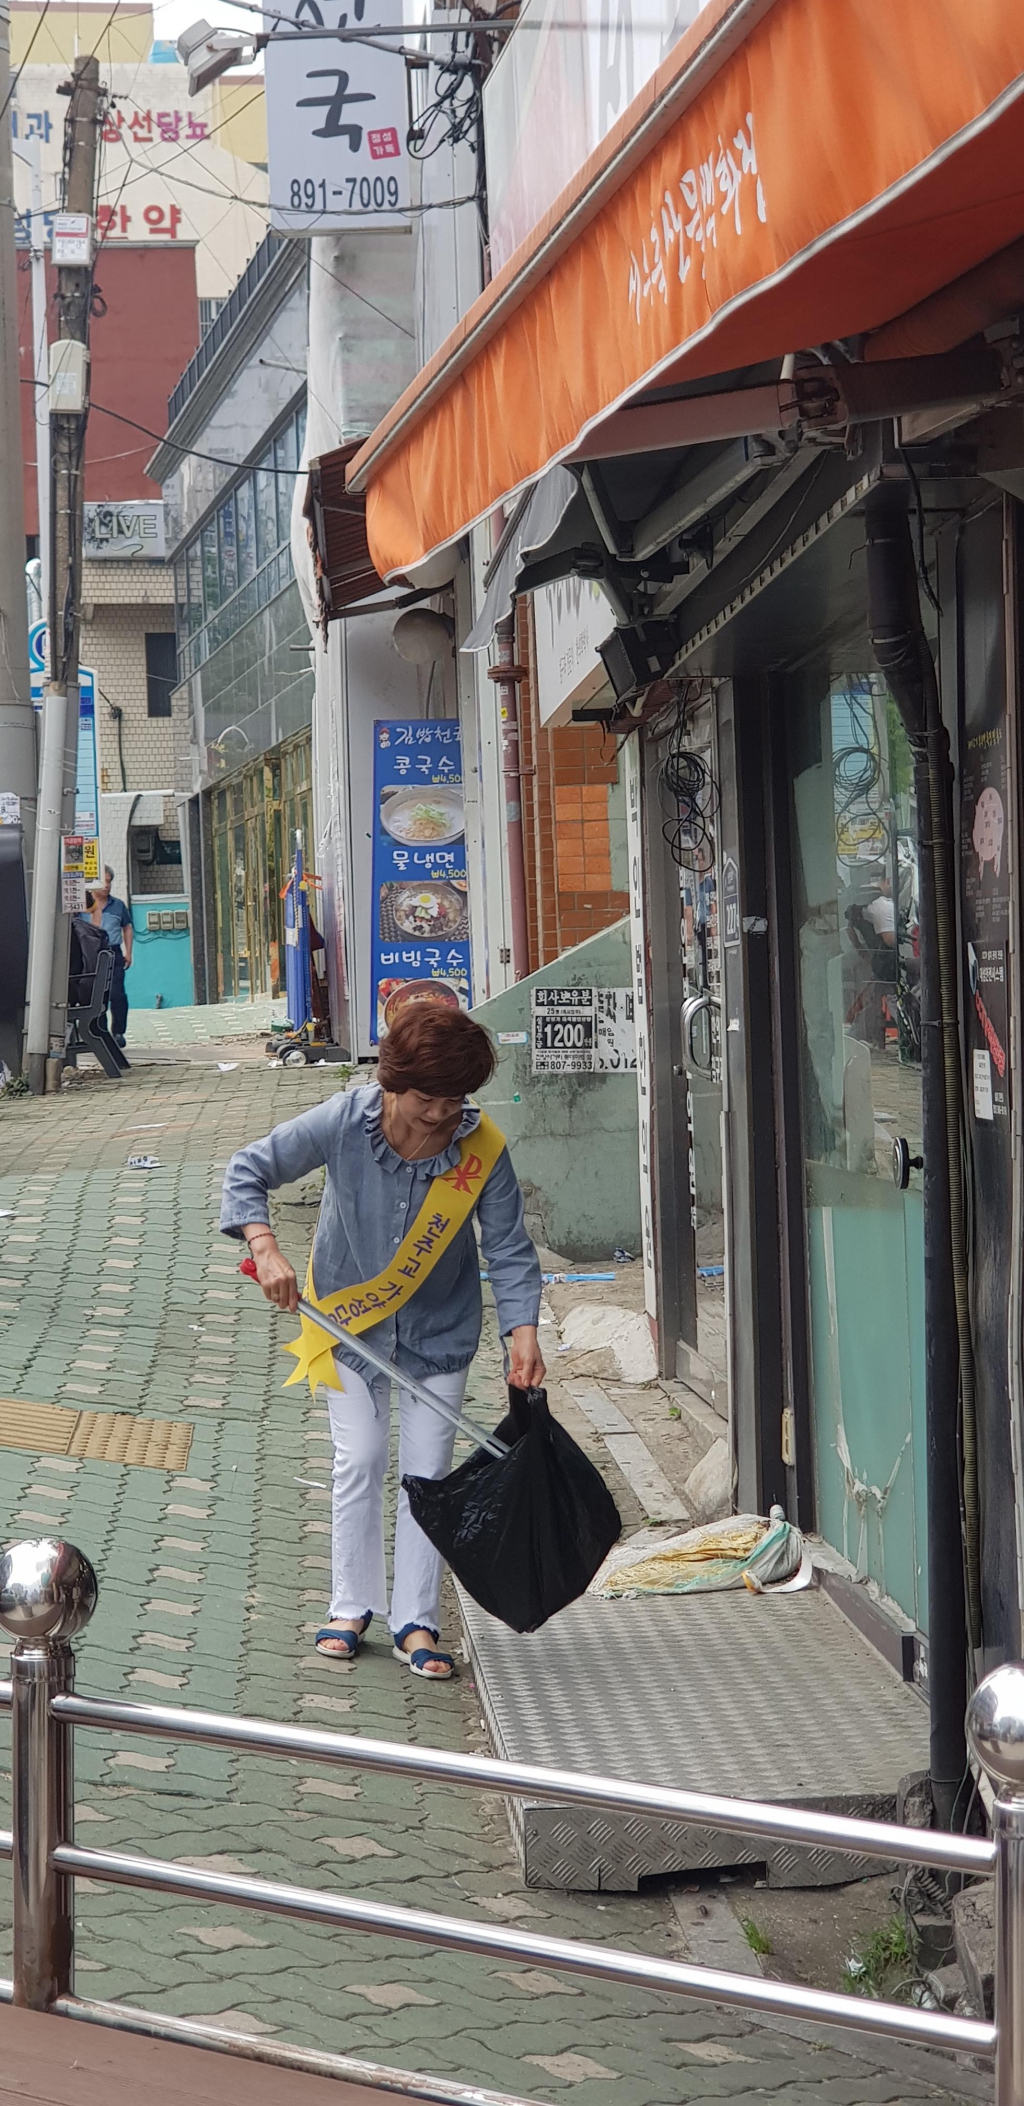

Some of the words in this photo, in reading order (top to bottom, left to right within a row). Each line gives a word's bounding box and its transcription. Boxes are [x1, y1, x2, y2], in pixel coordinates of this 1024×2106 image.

[290, 176, 399, 210] 891-7009
[94, 514, 158, 539] LIVE
[393, 755, 456, 775] 콩국수
[392, 850, 455, 871] 물냉면
[537, 989, 592, 1006] 회사보유분
[550, 1061, 593, 1070] 807-9933
[397, 1212, 451, 1279] 천주교
